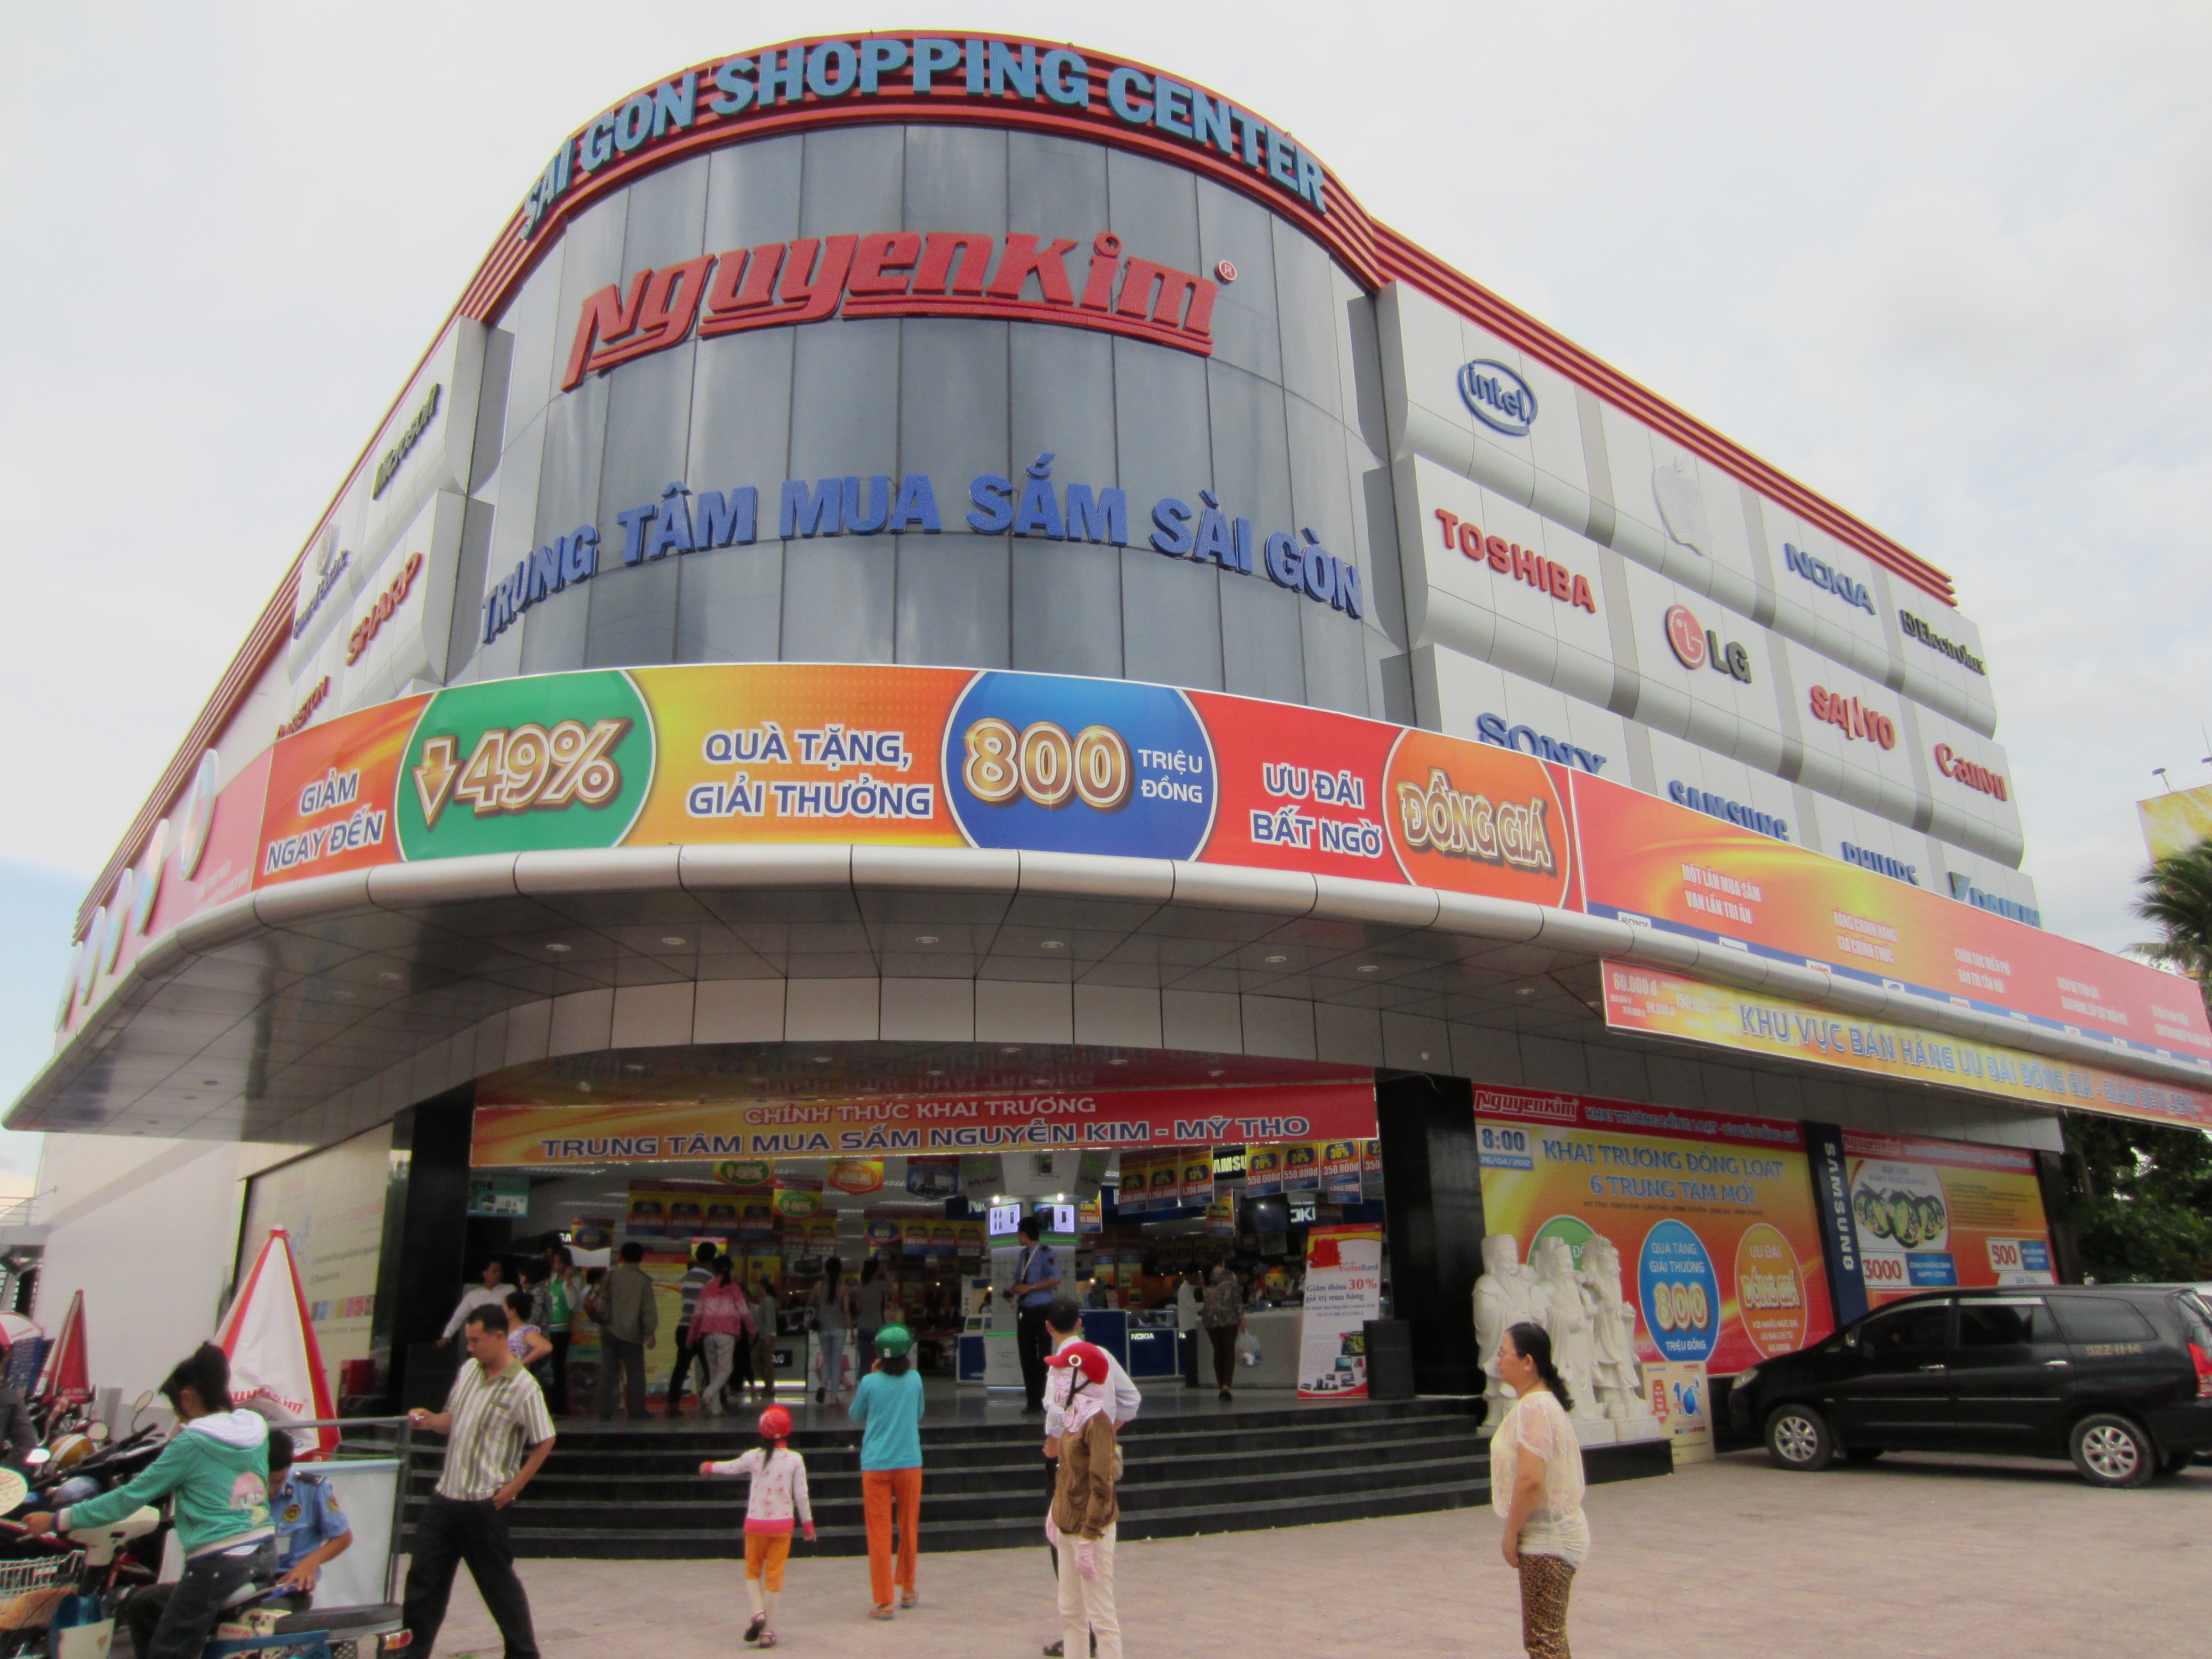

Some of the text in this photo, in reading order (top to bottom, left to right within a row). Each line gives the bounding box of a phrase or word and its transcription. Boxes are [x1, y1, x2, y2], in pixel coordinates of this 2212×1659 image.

[710, 36, 1090, 115] SHOPPING
[1107, 66, 1327, 216] CENTER
[1468, 362, 1531, 422] intel
[482, 452, 1363, 645] TRUNG TÂM MUA SẮM SÀI GÒN
[1435, 508, 1597, 614] TOSHIBA
[1783, 542, 1876, 615] NOKIA
[1705, 628, 1752, 684] LG
[1810, 685, 1896, 750] SANYO
[702, 721, 912, 772] QUÀ TẶNG,
[962, 717, 1131, 810] 800
[1138, 749, 1203, 775] TRIỆU
[1477, 712, 1607, 775] SONY
[455, 718, 633, 818] 49%
[1141, 775, 1203, 804] ĐỒNG
[1262, 763, 1365, 809] ƯU ĐÃI
[1935, 743, 2008, 802] Canon
[300, 769, 359, 816] GIẢM
[686, 772, 933, 819] GIẢI THƯỞNG
[1670, 779, 1790, 843] SAMSUNG
[264, 804, 387, 875] NGAY ĐẾN
[1250, 805, 1384, 858] BẤT NGỜ
[1397, 767, 1555, 873] ĐỒNG GIÁ
[1681, 862, 1762, 902] MỘT LẦN MUA SẮM
[1685, 890, 1705, 913] VẠN
[1707, 894, 1723, 915] LẦN
[1723, 901, 1739, 920] TRI
[1740, 1003, 1791, 1042] KHU
[1793, 1014, 1845, 1053] VỰC
[1849, 1024, 1897, 1062] BÁN
[1900, 1033, 1957, 1073] HÀNG
[1957, 1046, 1984, 1078] ƯU
[1986, 1053, 2018, 1085] ĐÃI
[2018, 1055, 2067, 1094] ĐỒNG
[2067, 1070, 2095, 1099] GIÁ
[744, 1095, 1097, 1125] CHÍNH THỨC KHAI TRƯƠNG
[1584, 1107, 1613, 1121] KHAI
[542, 1136, 660, 1158] TRUNG
[666, 1133, 744, 1155] TÂM
[750, 1131, 833, 1154] MUA
[837, 1123, 927, 1151] SẮM
[929, 1118, 1078, 1149] NGUYỄN
[1084, 1121, 1151, 1144] KIM
[1173, 1115, 1234, 1140] MỸ
[1236, 1116, 1311, 1139] THO
[1330, 1146, 1350, 1160] 36%
[1481, 1128, 1525, 1151] 8:00
[1323, 1162, 1359, 1176] 350.000đ
[1543, 1139, 1595, 1165] KHAI
[1685, 1146, 1741, 1175] ĐỒNG
[1743, 1157, 1783, 1183] LOẠT
[1590, 1174, 1757, 1205] 6 TRUNG TÂM MỚI
[1824, 1142, 1855, 1271] SAMSUNG
[1339, 1263, 1380, 1272] VietinBank
[1650, 1258, 1668, 1273] GIẢI
[1651, 1242, 1671, 1255] QUÀ
[1863, 1259, 1902, 1280] 3000
[1992, 1244, 2018, 1265] 500
[1306, 1295, 1316, 1303] giá
[1346, 1293, 1364, 1301] hàng
[1653, 1281, 1709, 1332] 800
[1130, 1332, 1155, 1340] NOKIA
[1665, 1337, 1707, 1353] TRIỆU ĐỒNG
